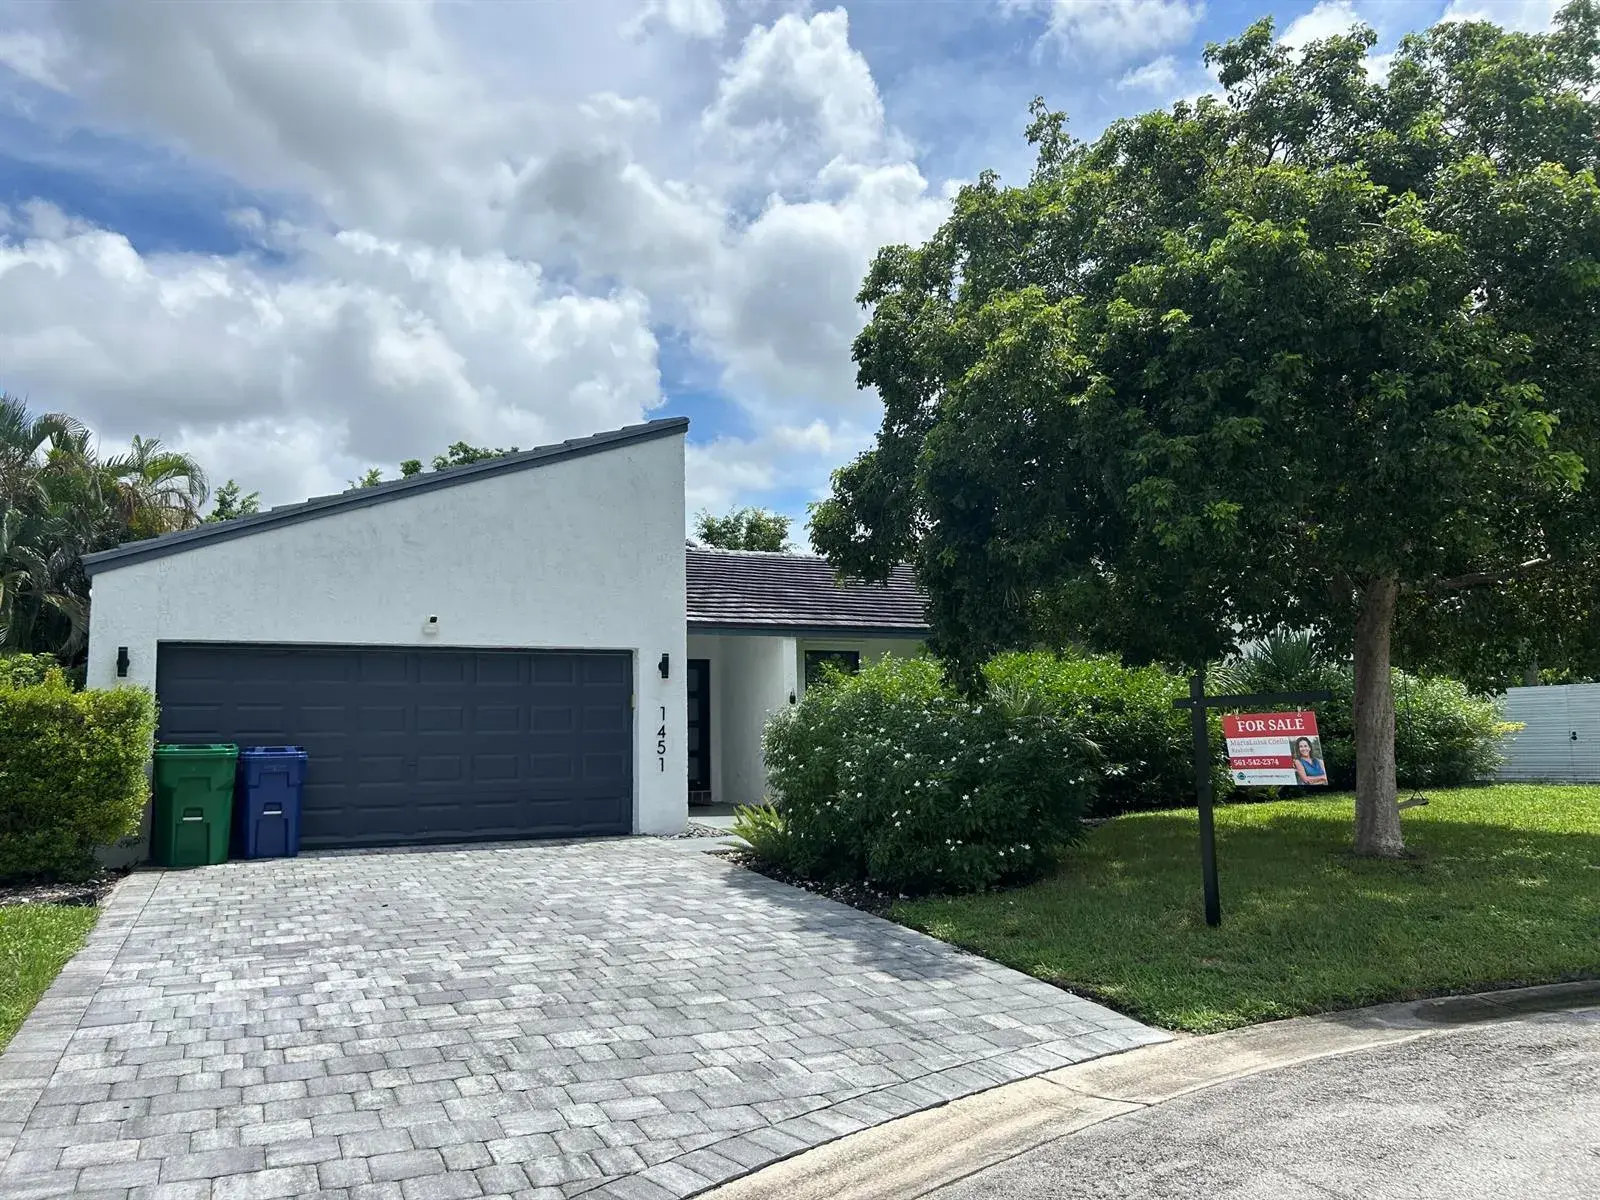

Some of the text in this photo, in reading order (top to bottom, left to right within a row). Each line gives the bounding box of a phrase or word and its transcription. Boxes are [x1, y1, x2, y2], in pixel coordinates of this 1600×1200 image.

[1237, 718, 1305, 732] FOR SALE
[657, 706, 666, 772] 1451
[1233, 758, 1280, 766] 561-542-2374
